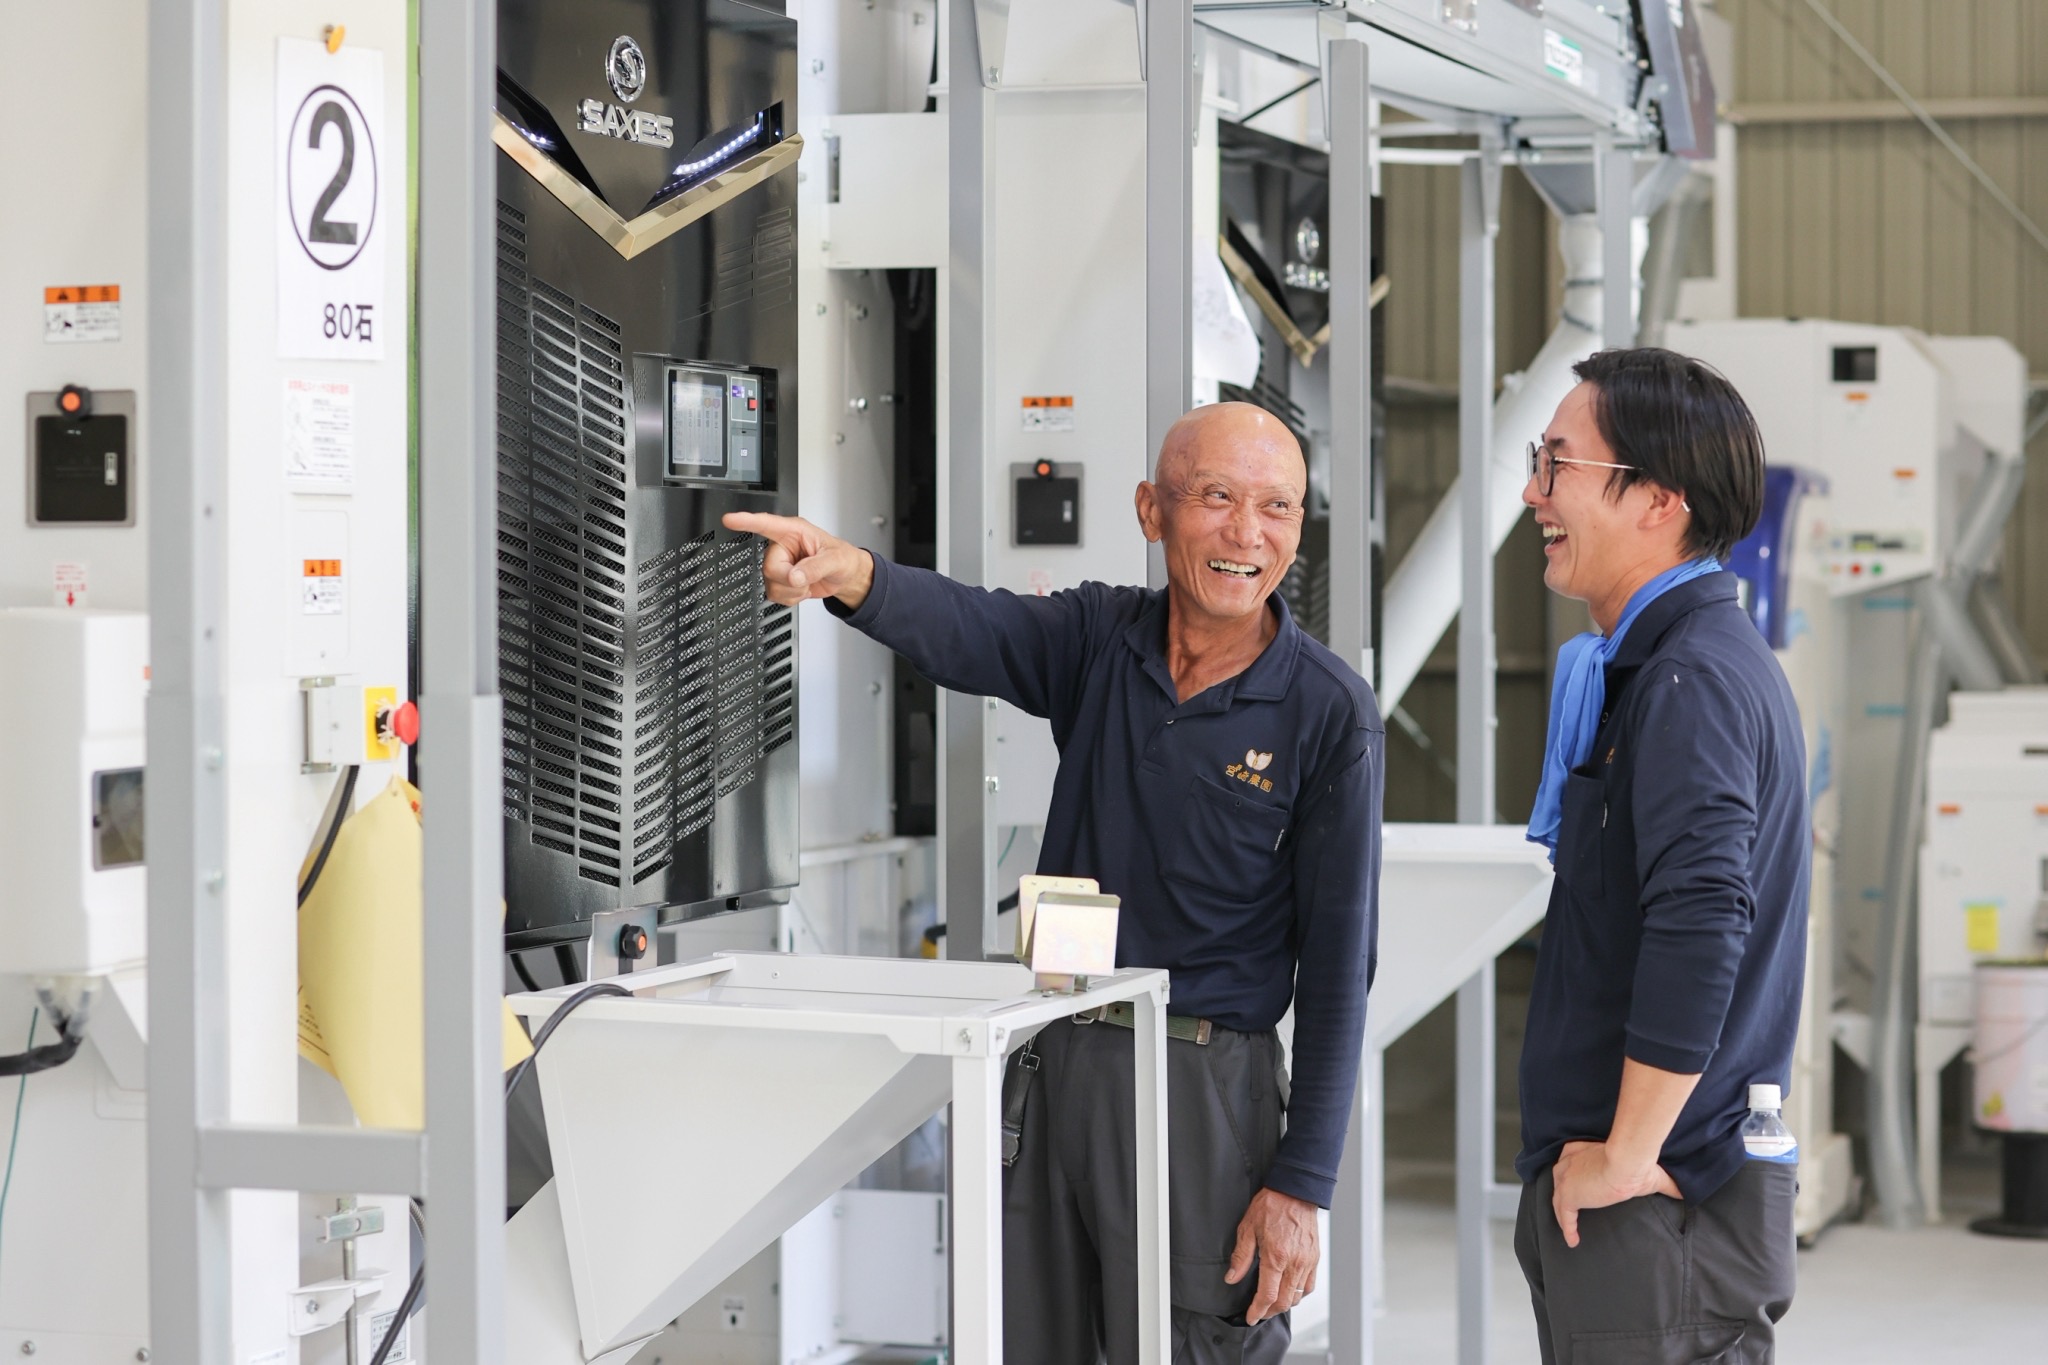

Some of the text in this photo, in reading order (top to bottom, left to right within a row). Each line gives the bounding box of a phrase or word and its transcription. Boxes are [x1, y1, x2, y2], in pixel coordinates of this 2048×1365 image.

[577, 98, 674, 149] SAXES
[308, 100, 358, 246] 2
[323, 302, 374, 342] 80石
